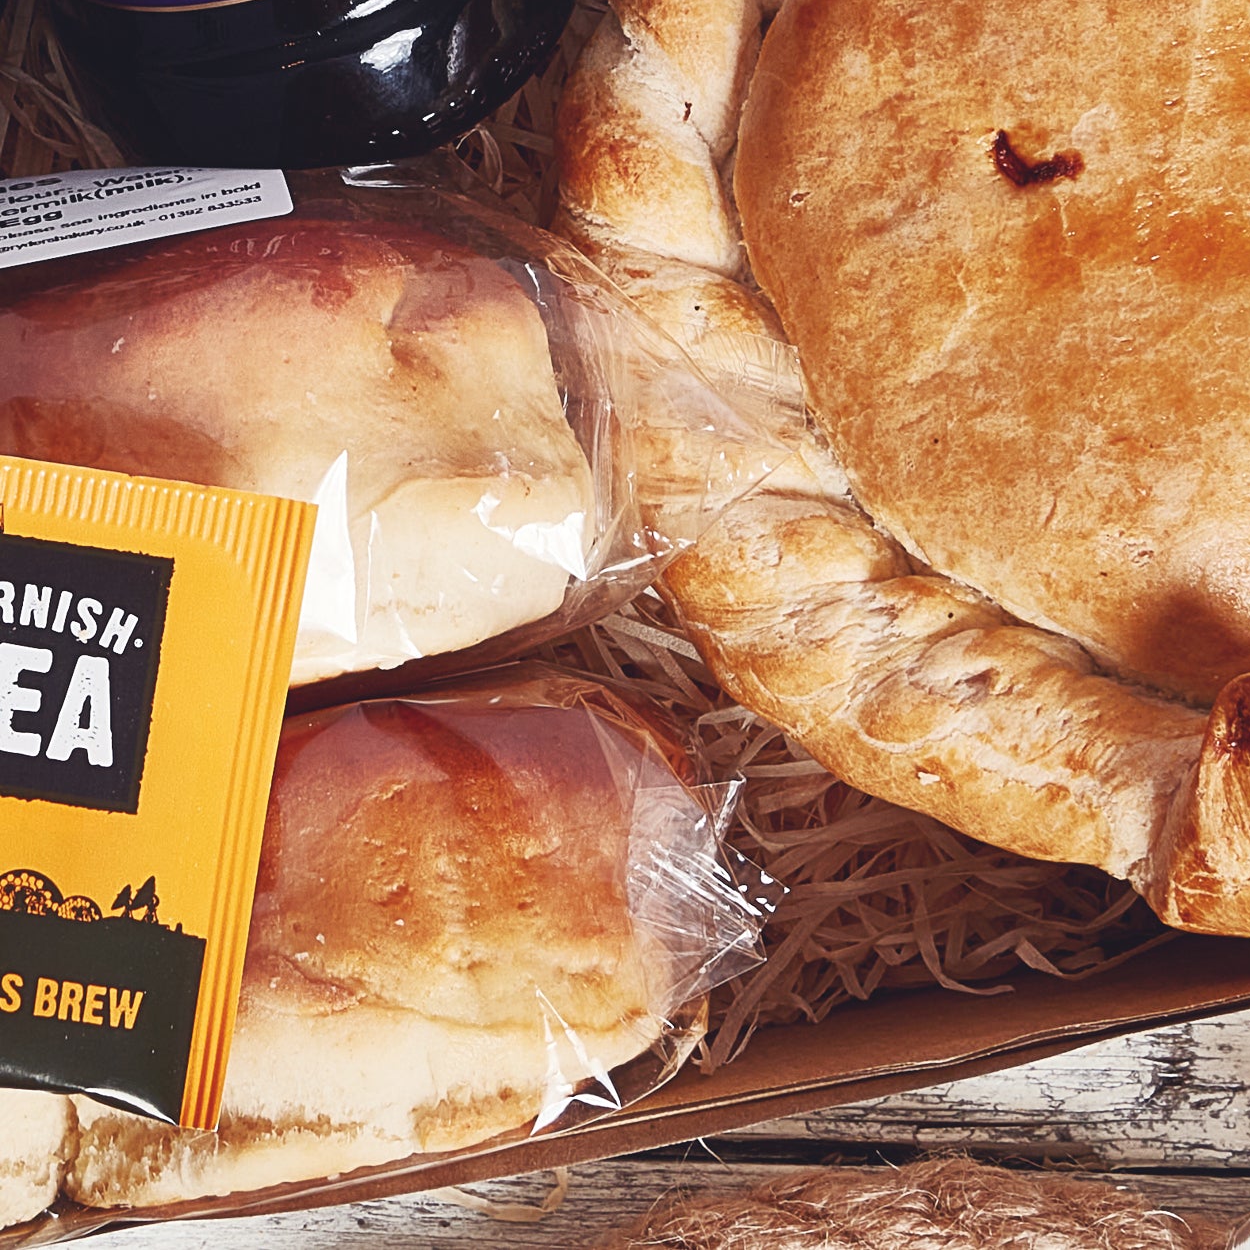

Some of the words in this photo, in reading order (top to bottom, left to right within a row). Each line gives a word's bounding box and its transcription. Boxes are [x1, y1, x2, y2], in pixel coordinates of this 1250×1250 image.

[220, 182, 261, 196] bold
[0, 210, 62, 229] Egg
[33, 977, 144, 1030] BREW
